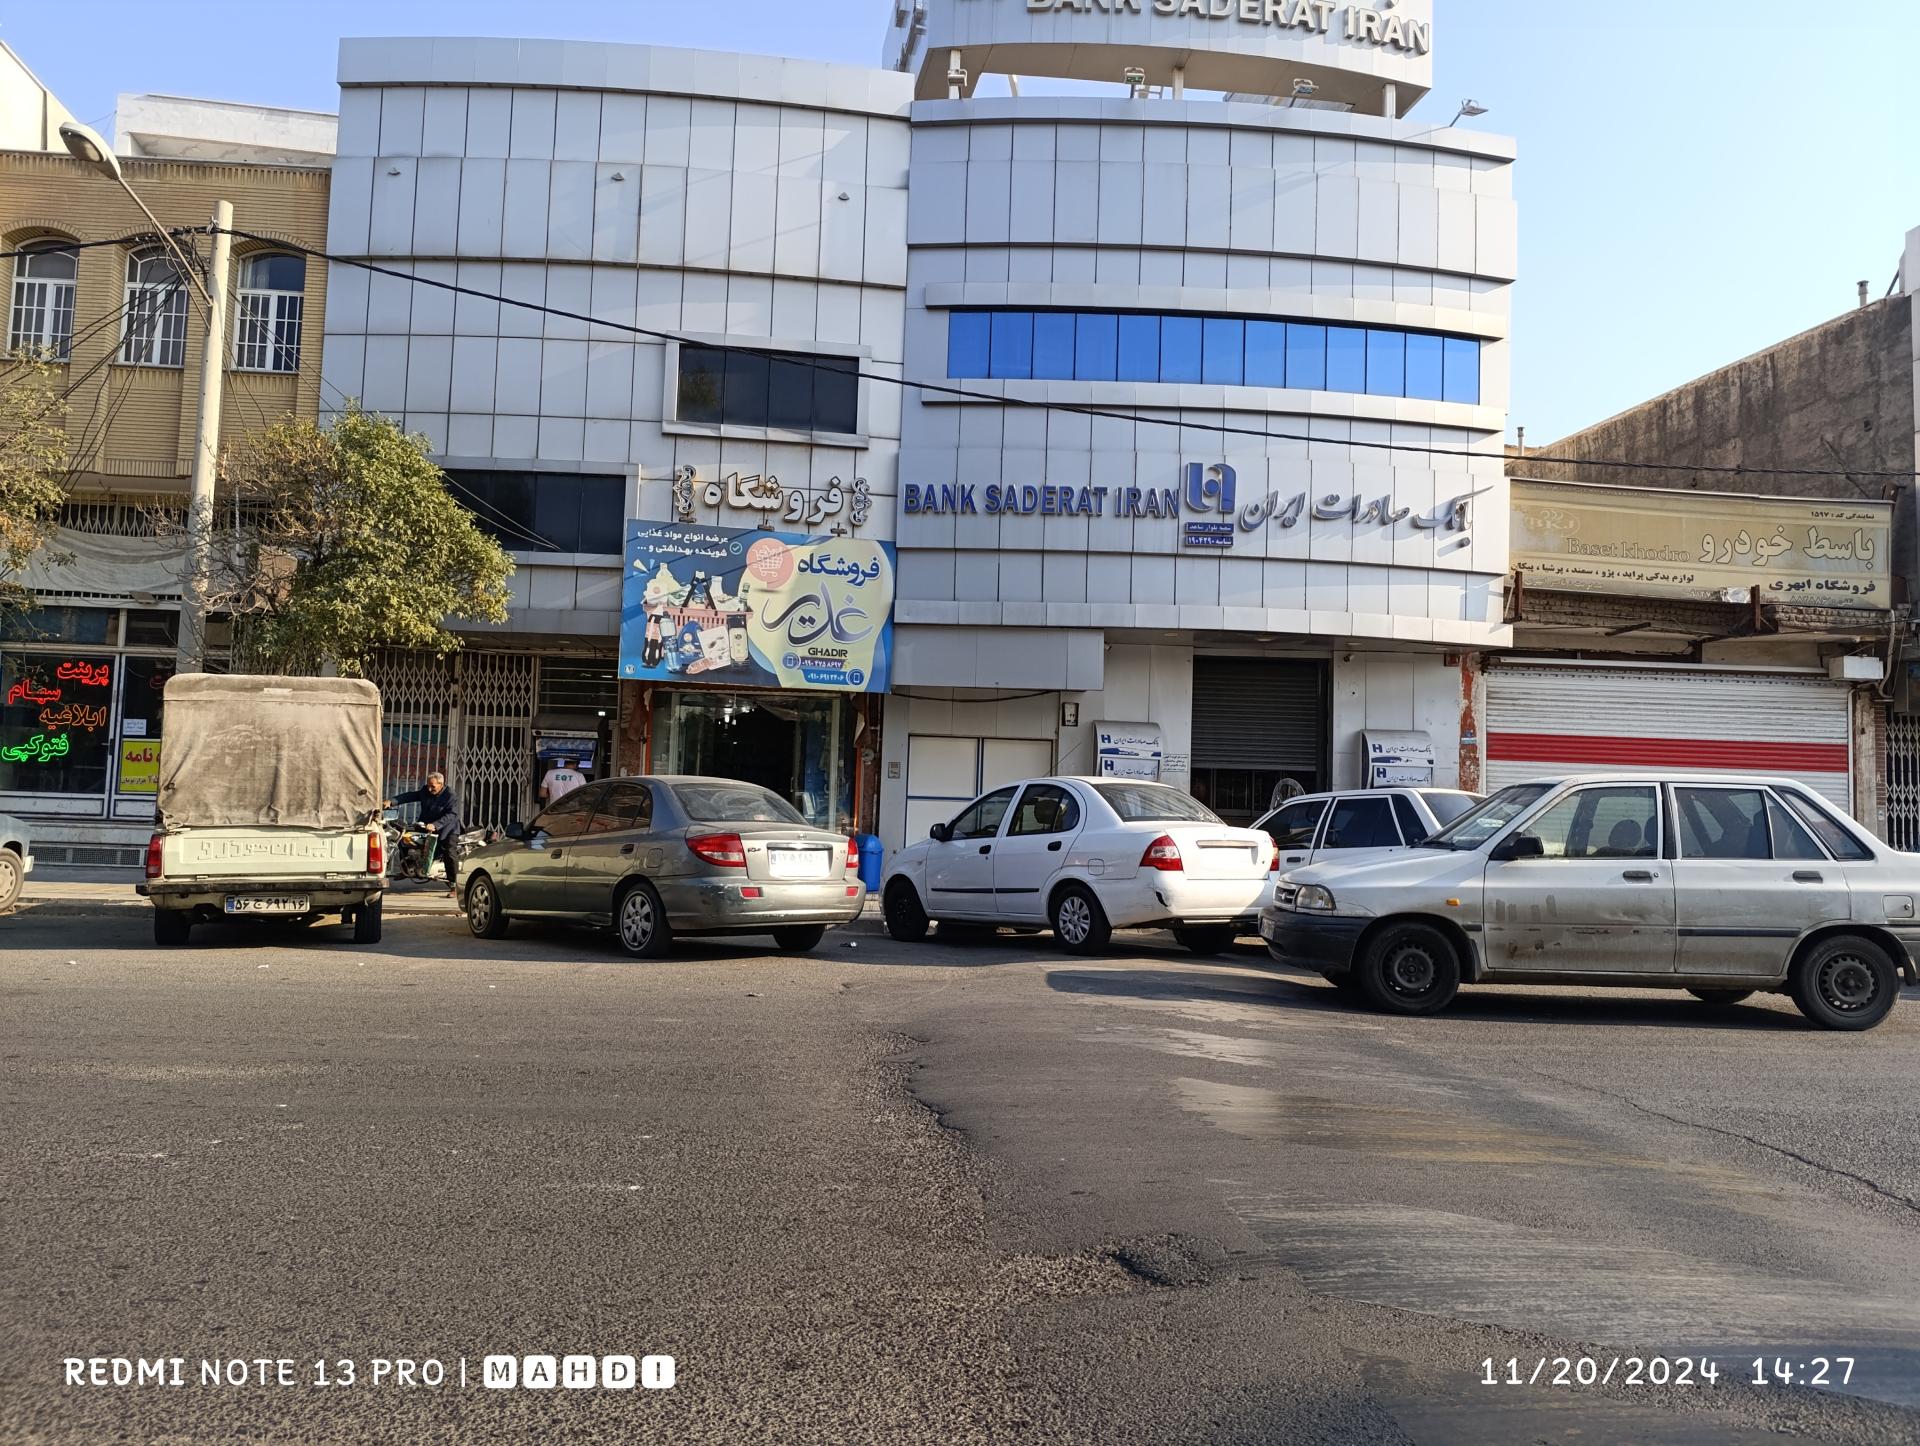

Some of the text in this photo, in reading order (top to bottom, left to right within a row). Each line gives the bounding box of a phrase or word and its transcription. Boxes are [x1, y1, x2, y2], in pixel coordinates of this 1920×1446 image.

[1345, 6, 1430, 55] IRAN
[703, 471, 844, 525] فروشگاه
[904, 483, 1180, 518] BANK SADERAT IRAN
[1239, 489, 1306, 531] ایران
[1313, 494, 1410, 525] صادرات
[637, 528, 728, 544] عرضه انواع مواد غذایی
[1698, 525, 1875, 570] باسط خودرو
[655, 544, 692, 556] بهداشتی
[695, 548, 728, 558] شوینده
[1566, 537, 1691, 563] Baset khodro
[797, 552, 880, 586] فروشگاه
[1671, 574, 1694, 584] لوازم
[1769, 579, 1876, 595] فروشگاه ابهری
[807, 647, 848, 658] GHADIR
[57, 661, 109, 686] پرینت
[8, 680, 62, 704] سهام
[39, 704, 107, 731] ابلاغیه
[1, 734, 70, 762] فتوکپی
[125, 747, 153, 763] نامه
[235, 898, 249, 910] ۵۶
[266, 898, 288, 909] ۶۹۲
[292, 900, 304, 909] ۱۶
